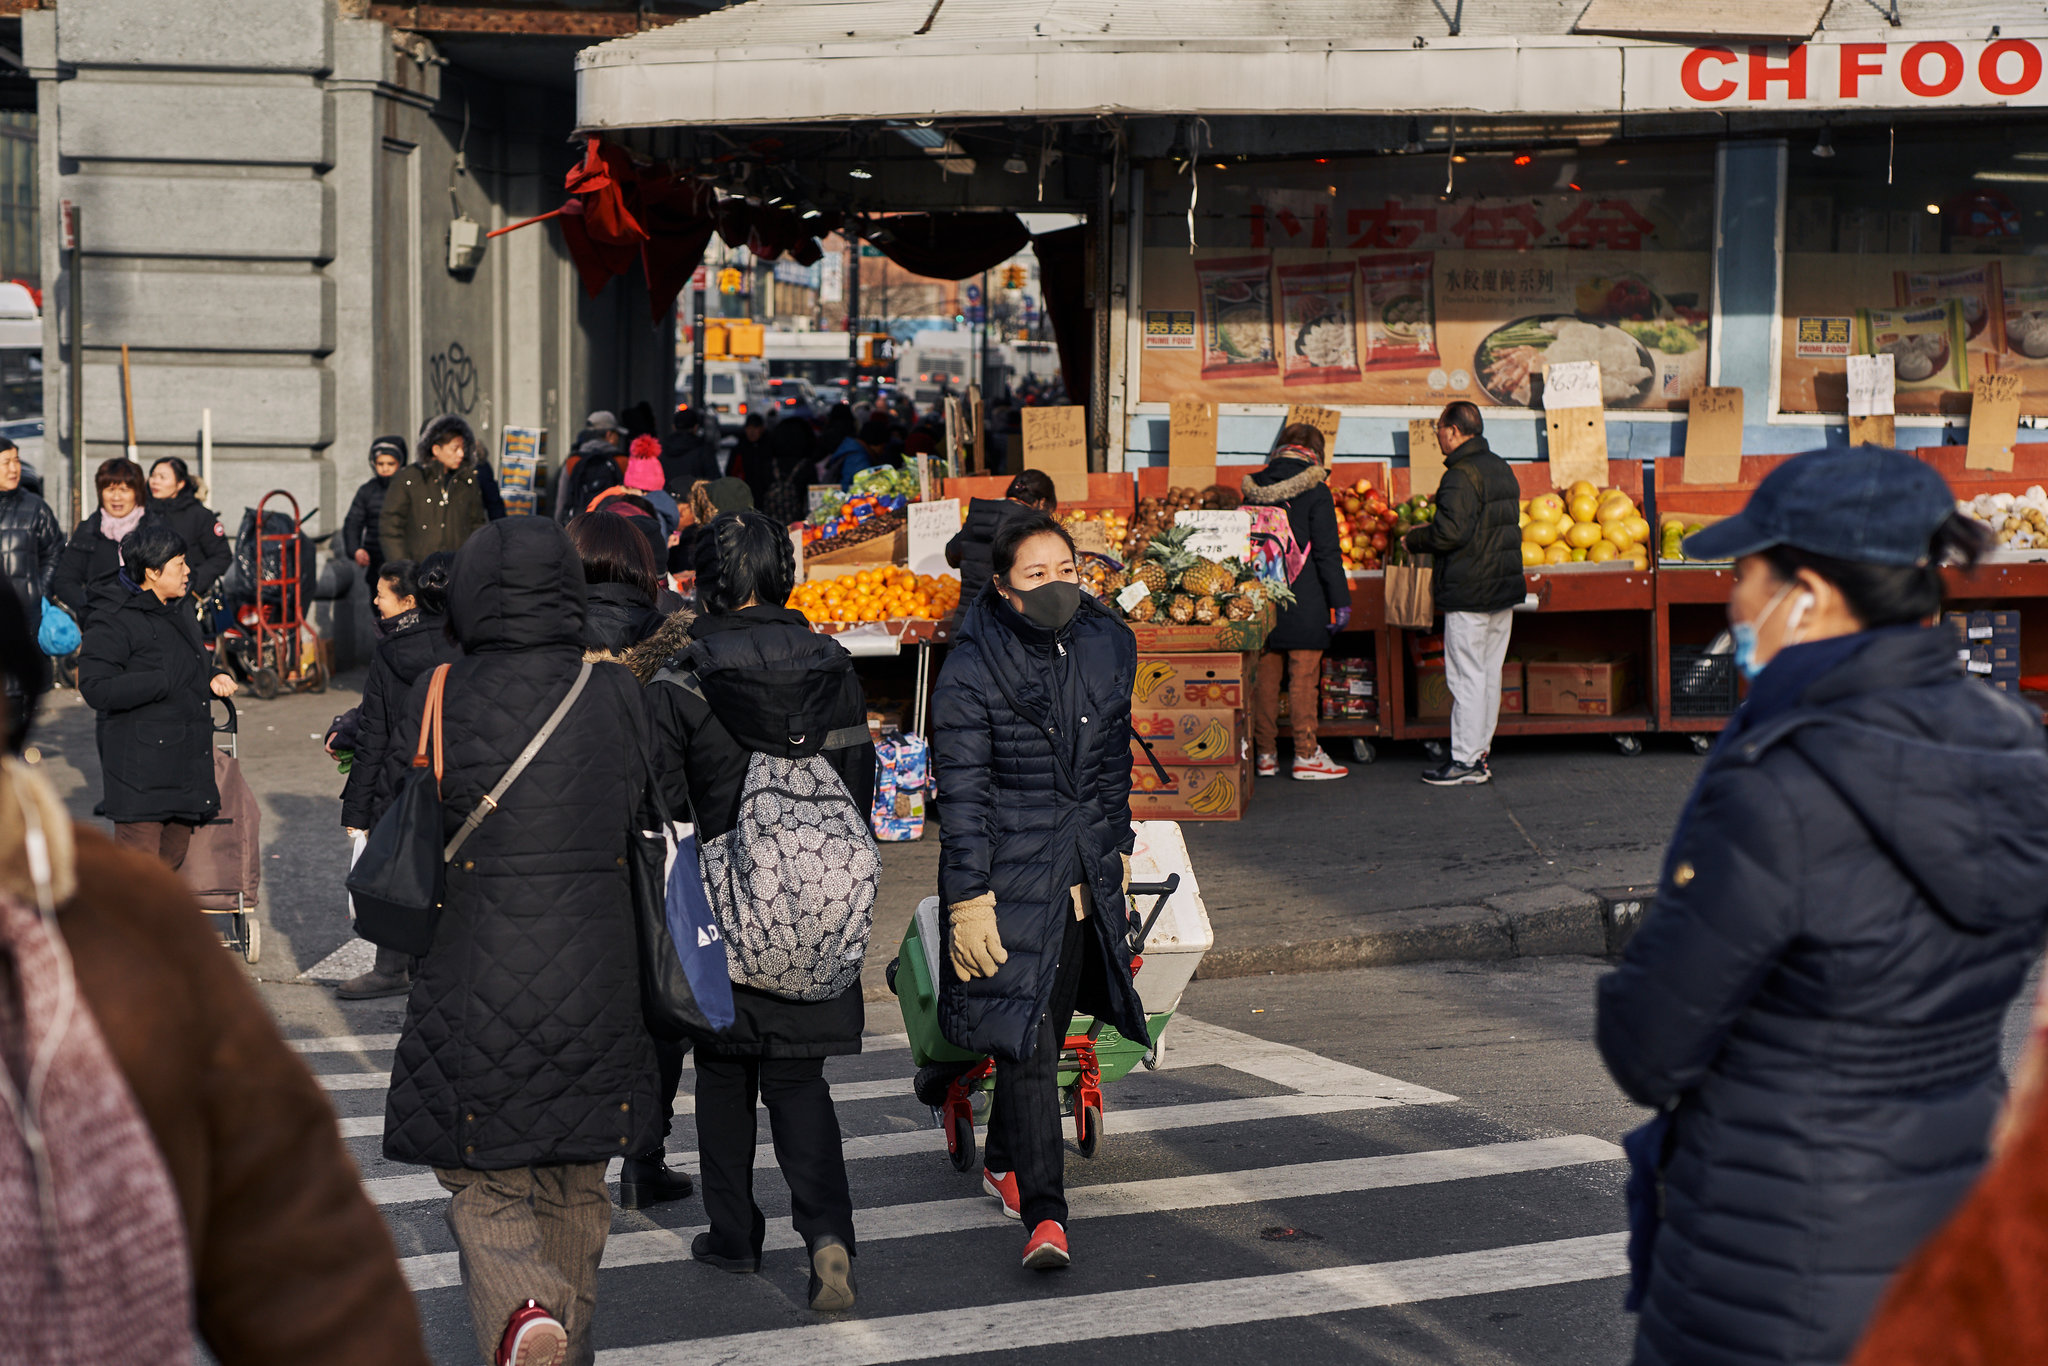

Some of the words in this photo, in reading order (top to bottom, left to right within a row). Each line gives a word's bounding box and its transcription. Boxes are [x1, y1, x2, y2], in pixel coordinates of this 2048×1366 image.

[1681, 43, 1807, 102] CH
[1840, 38, 2043, 98] FOO
[1146, 337, 1169, 345] PRIME
[1172, 337, 1193, 345] FOOD
[1798, 344, 1822, 353] PRIME
[1826, 344, 1847, 353] FOOD
[1184, 683, 1240, 707] Dole
[1130, 712, 1175, 737] ole
[707, 924, 723, 941] D
